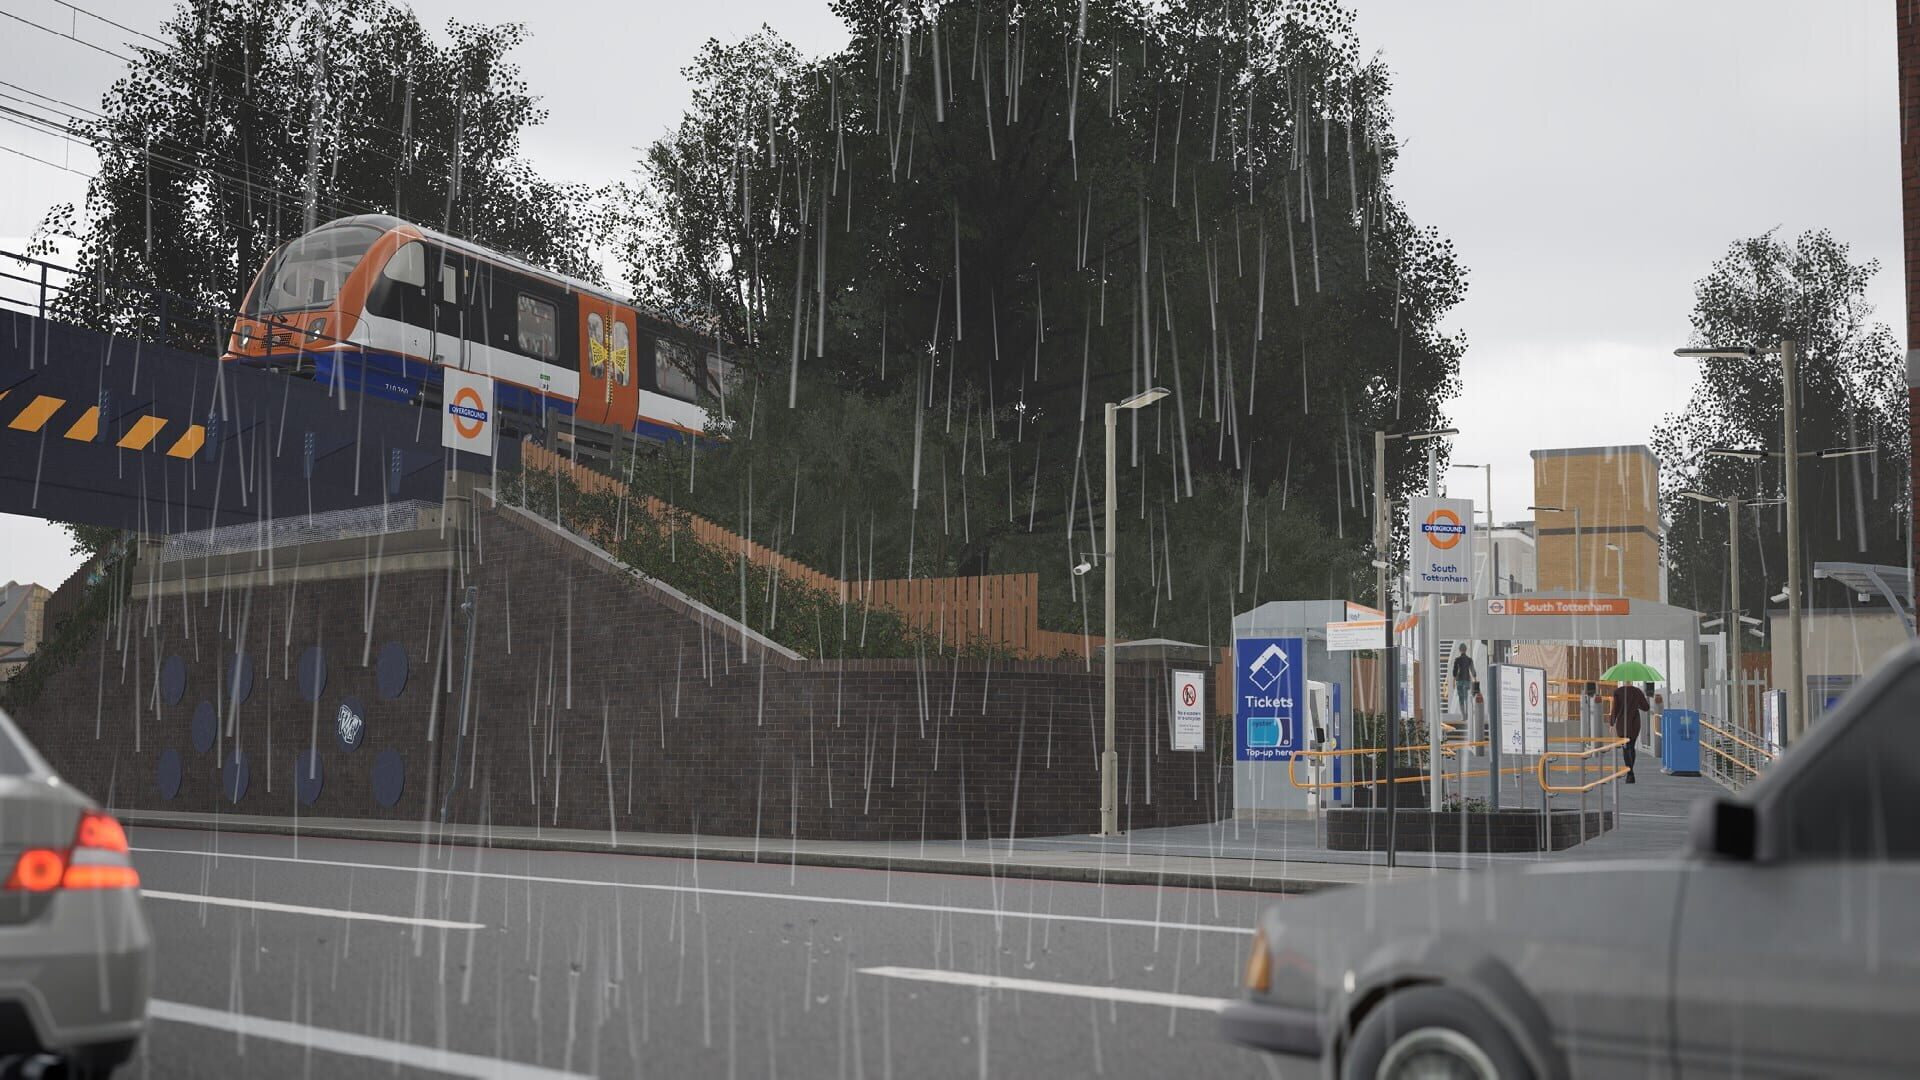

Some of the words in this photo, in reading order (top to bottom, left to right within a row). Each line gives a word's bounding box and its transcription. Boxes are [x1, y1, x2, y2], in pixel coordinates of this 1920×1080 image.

[451, 406, 486, 420] OVERGROUND
[1424, 524, 1464, 534] OVERGROUND
[1431, 563, 1457, 573] South
[1421, 573, 1469, 583] Tottenham
[1523, 600, 1555, 612] South
[1556, 600, 1613, 612] Tottenham
[1244, 695, 1294, 708] Tickets
[1244, 748, 1274, 758] Top-up
[1274, 748, 1294, 756] here
